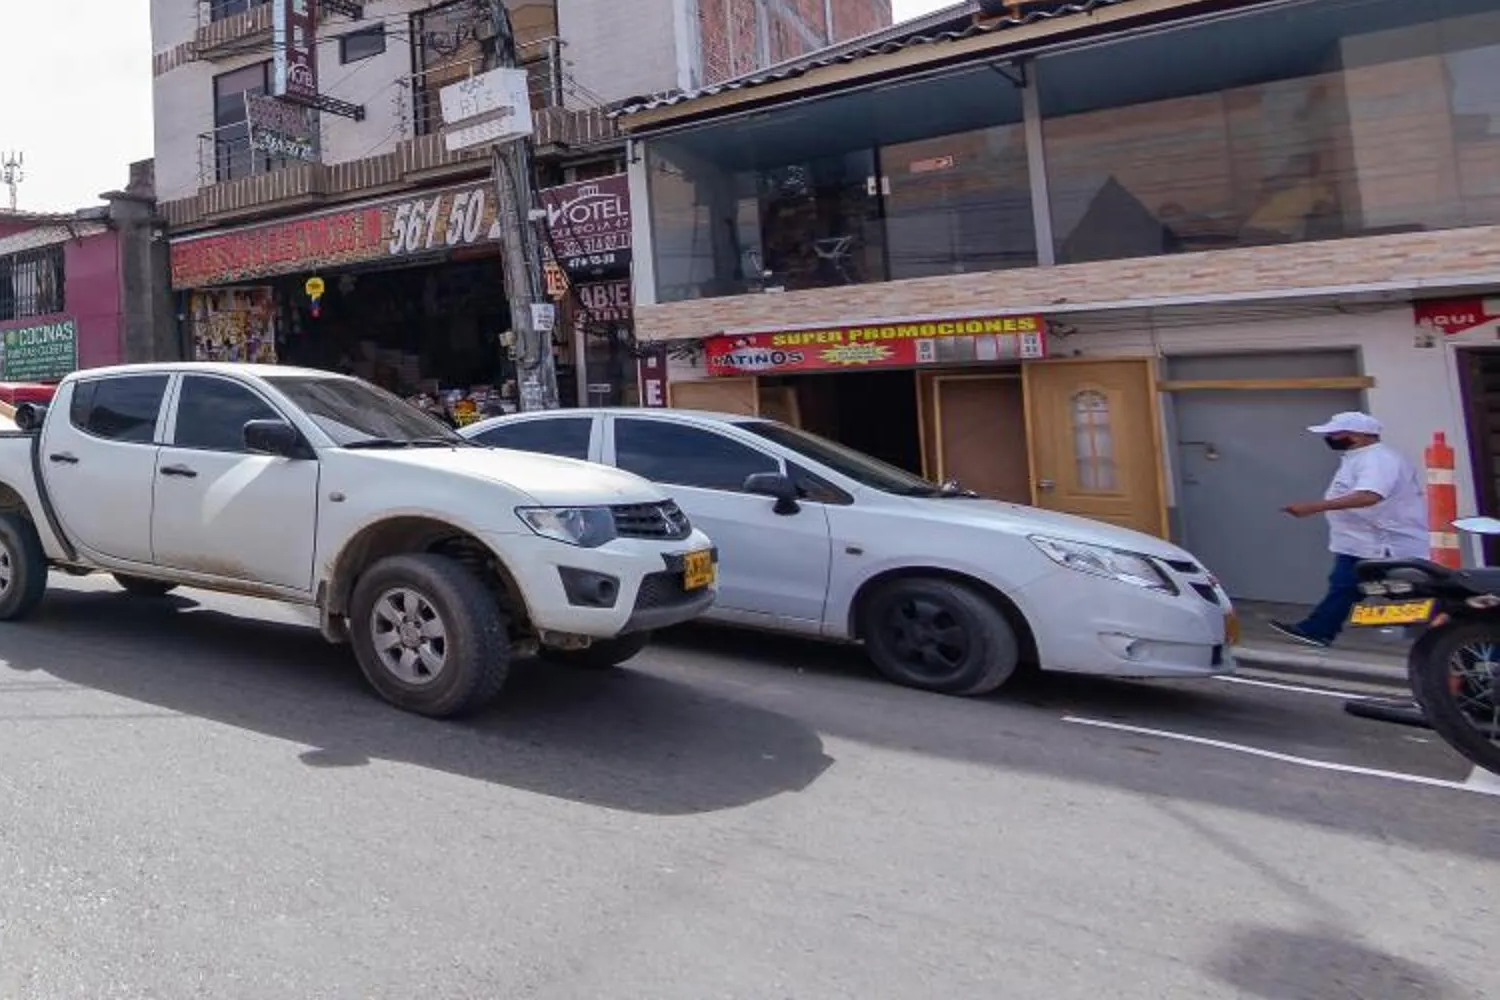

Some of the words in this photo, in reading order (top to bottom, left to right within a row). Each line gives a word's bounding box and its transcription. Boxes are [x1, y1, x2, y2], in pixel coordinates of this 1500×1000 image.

[388, 195, 443, 255] 561
[446, 188, 485, 246] 50
[547, 197, 628, 227] HOTEL
[19, 320, 73, 346] COCINAS
[772, 330, 843, 346] SUPER
[849, 317, 1037, 341] PROMOCIONES
